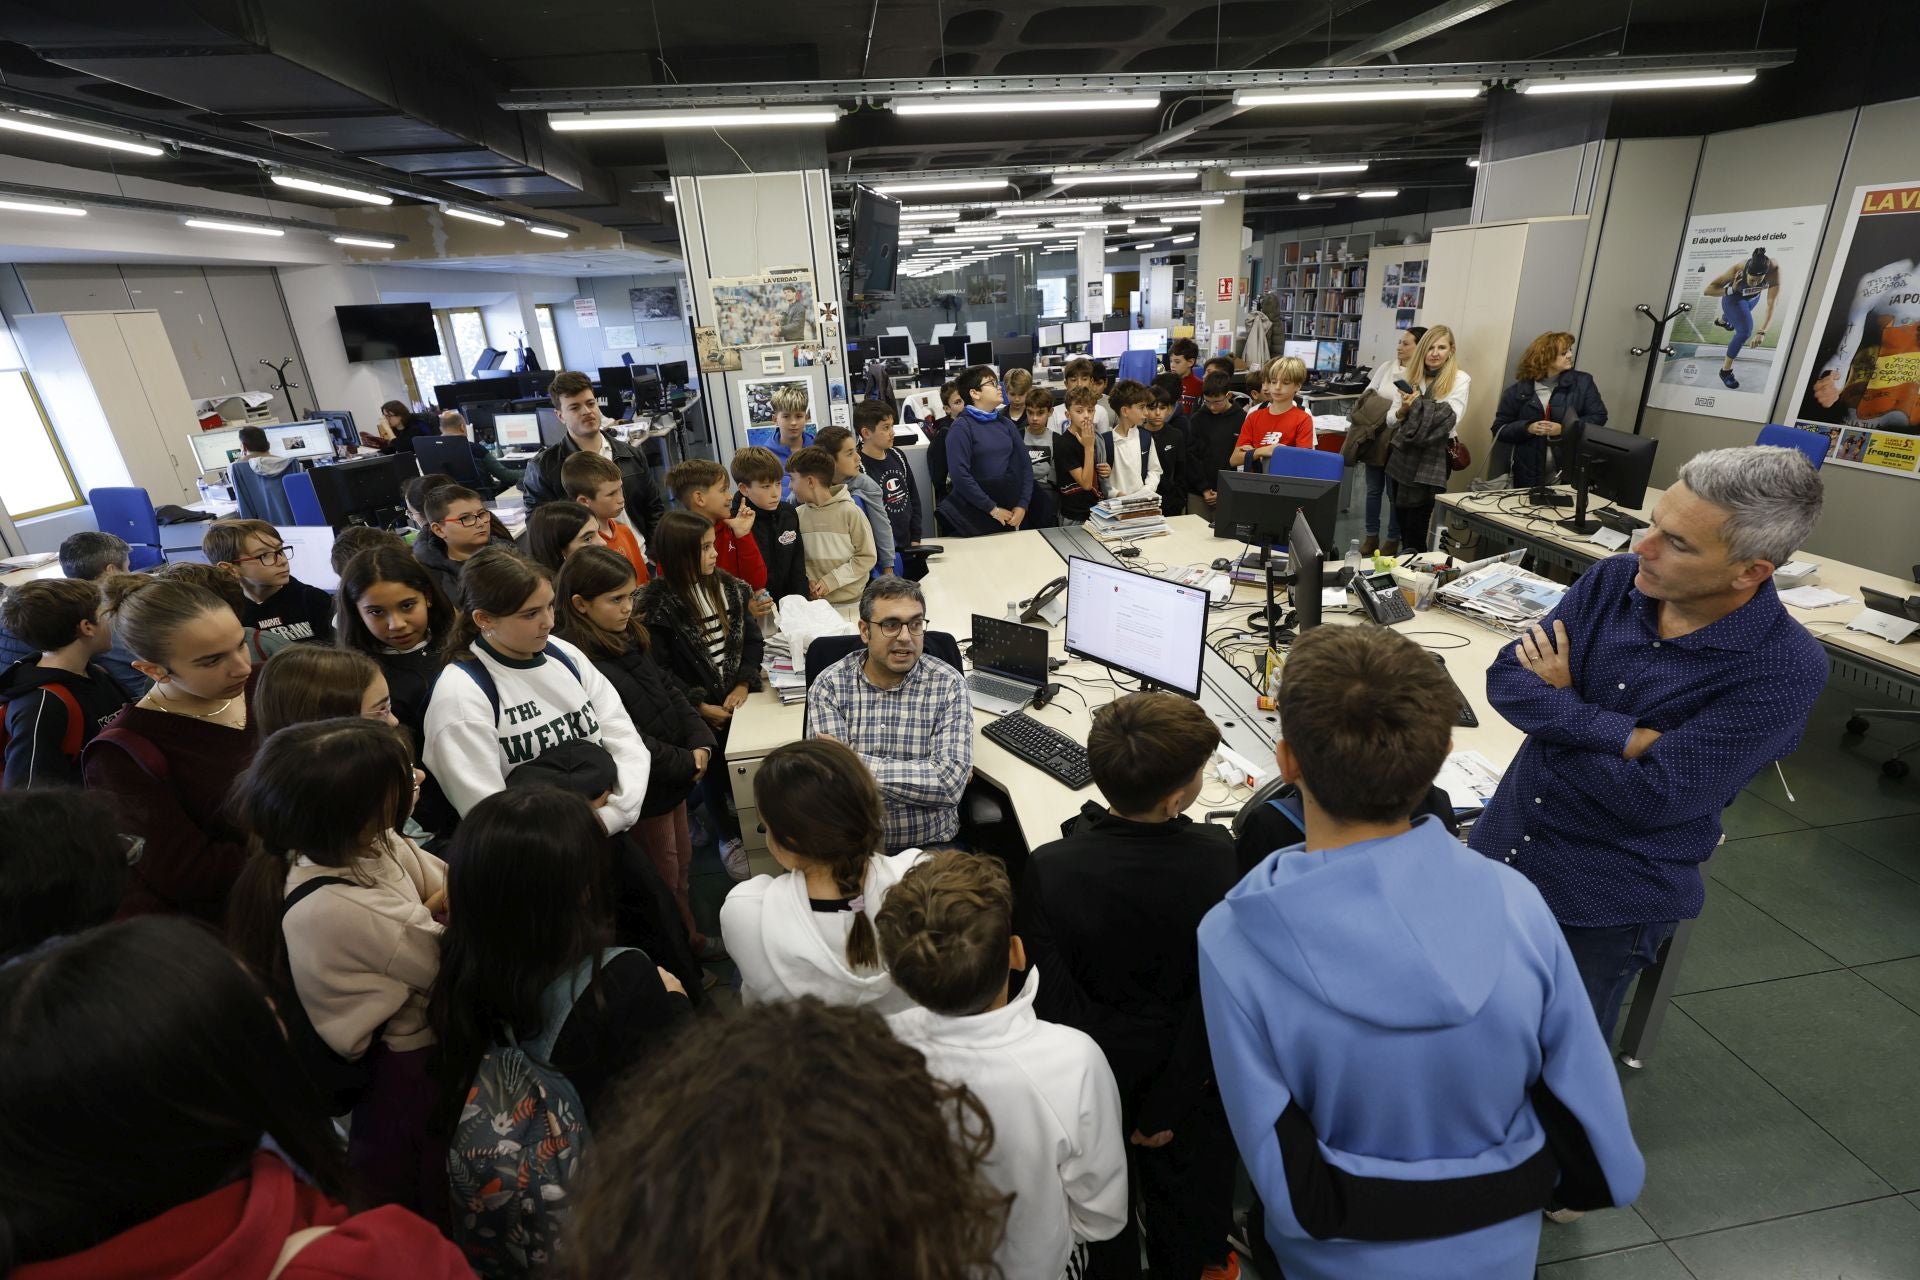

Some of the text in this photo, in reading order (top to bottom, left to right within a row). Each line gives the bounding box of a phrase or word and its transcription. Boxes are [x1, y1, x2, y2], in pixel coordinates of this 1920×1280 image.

[1864, 193, 1895, 212] LA
[1692, 231, 1787, 245] El día que Úrsula besó el cielo
[1902, 293, 1920, 304] PO
[258, 617, 282, 630] MARVEL
[504, 700, 542, 725] THE
[499, 700, 600, 765] WEEKE
